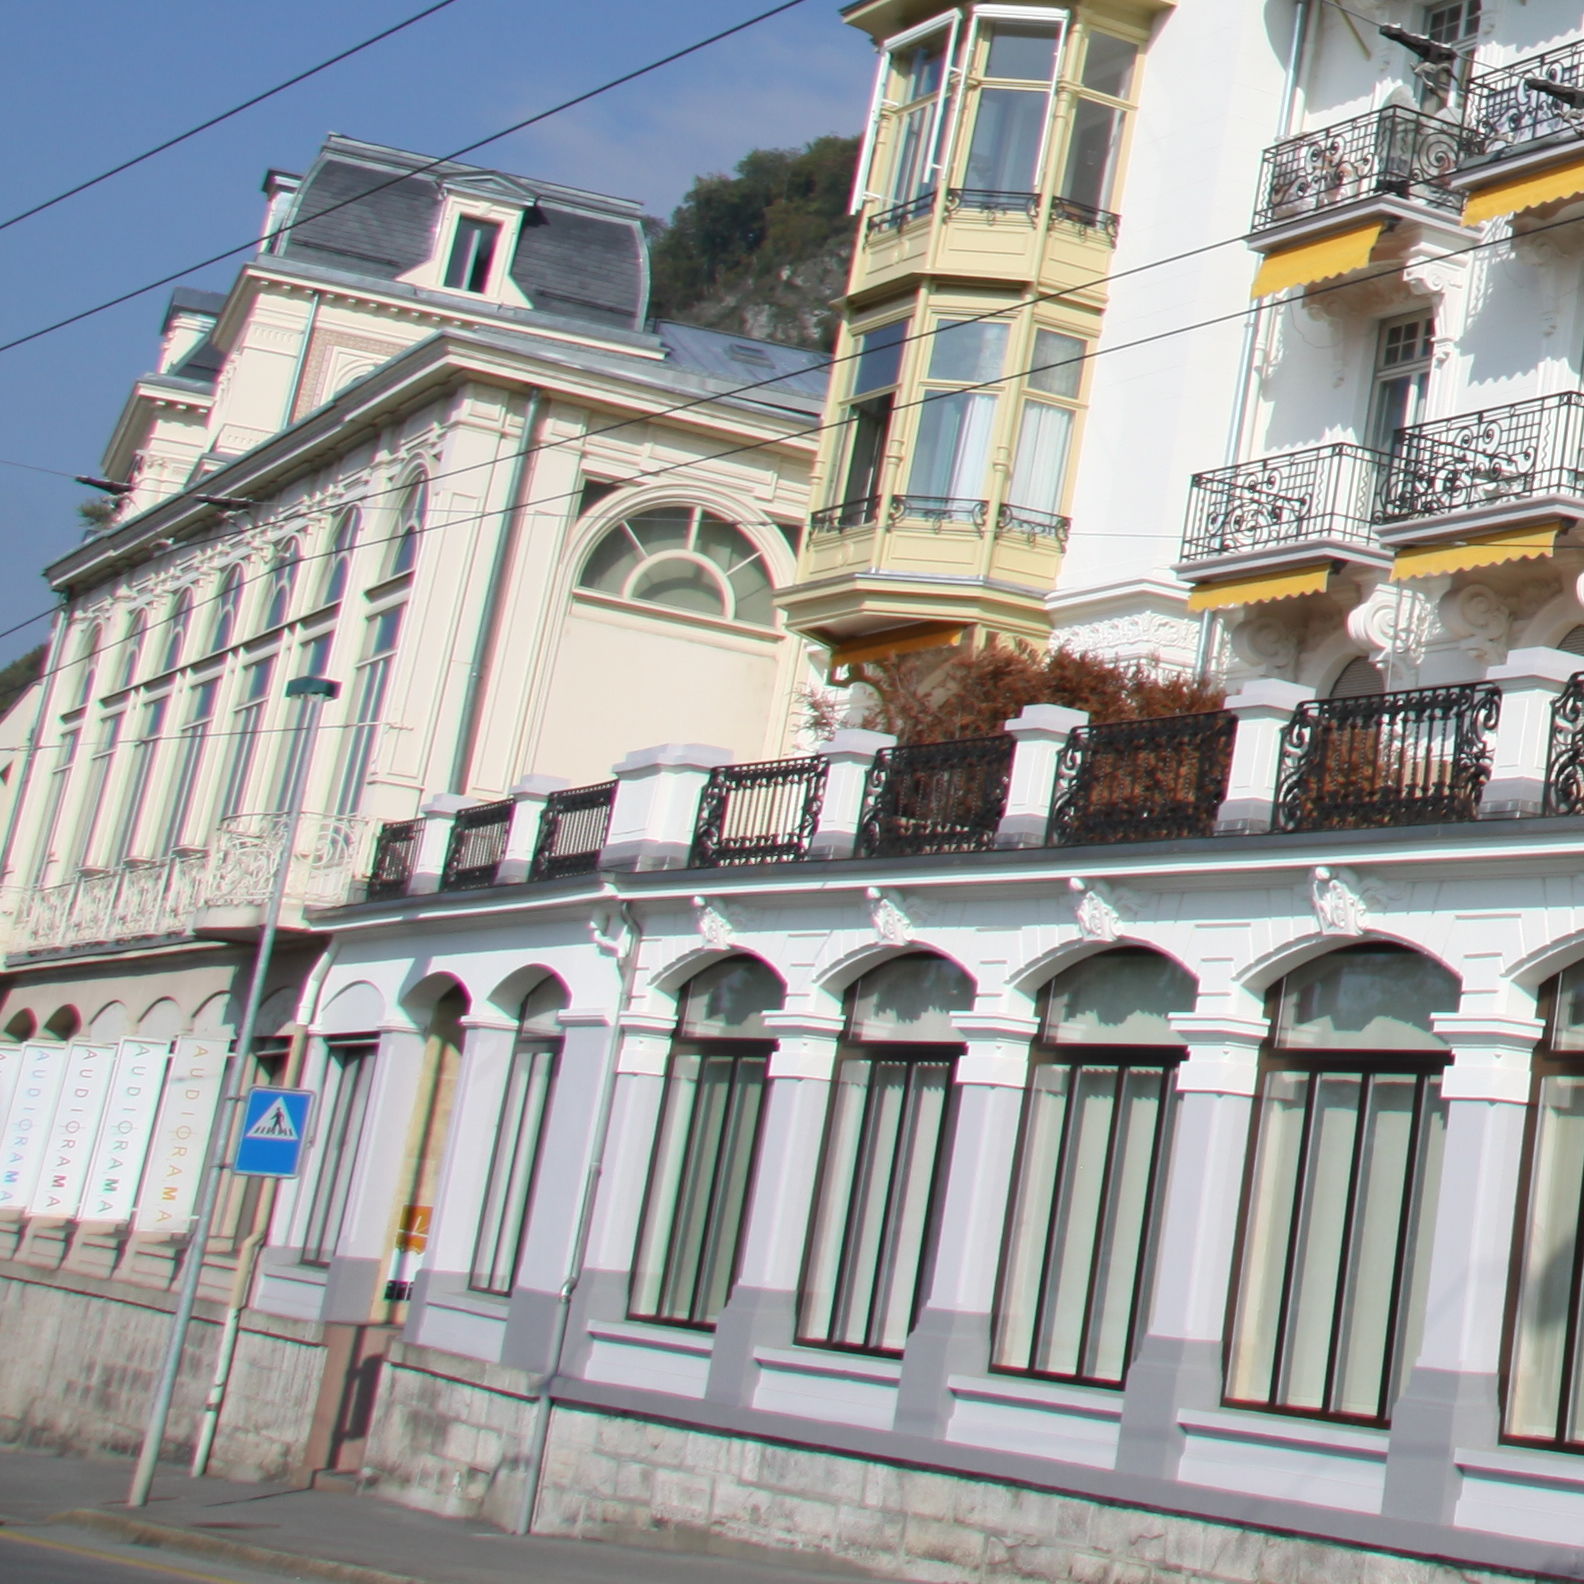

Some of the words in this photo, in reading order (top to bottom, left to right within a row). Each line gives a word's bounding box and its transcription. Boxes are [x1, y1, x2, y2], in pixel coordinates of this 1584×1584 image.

[0, 1050, 50, 1201] AUDIORAMA
[46, 1049, 97, 1208] AUDIORAMA
[98, 1045, 150, 1213] AUDIORAMA
[156, 1045, 208, 1222] AUDIORAMA
